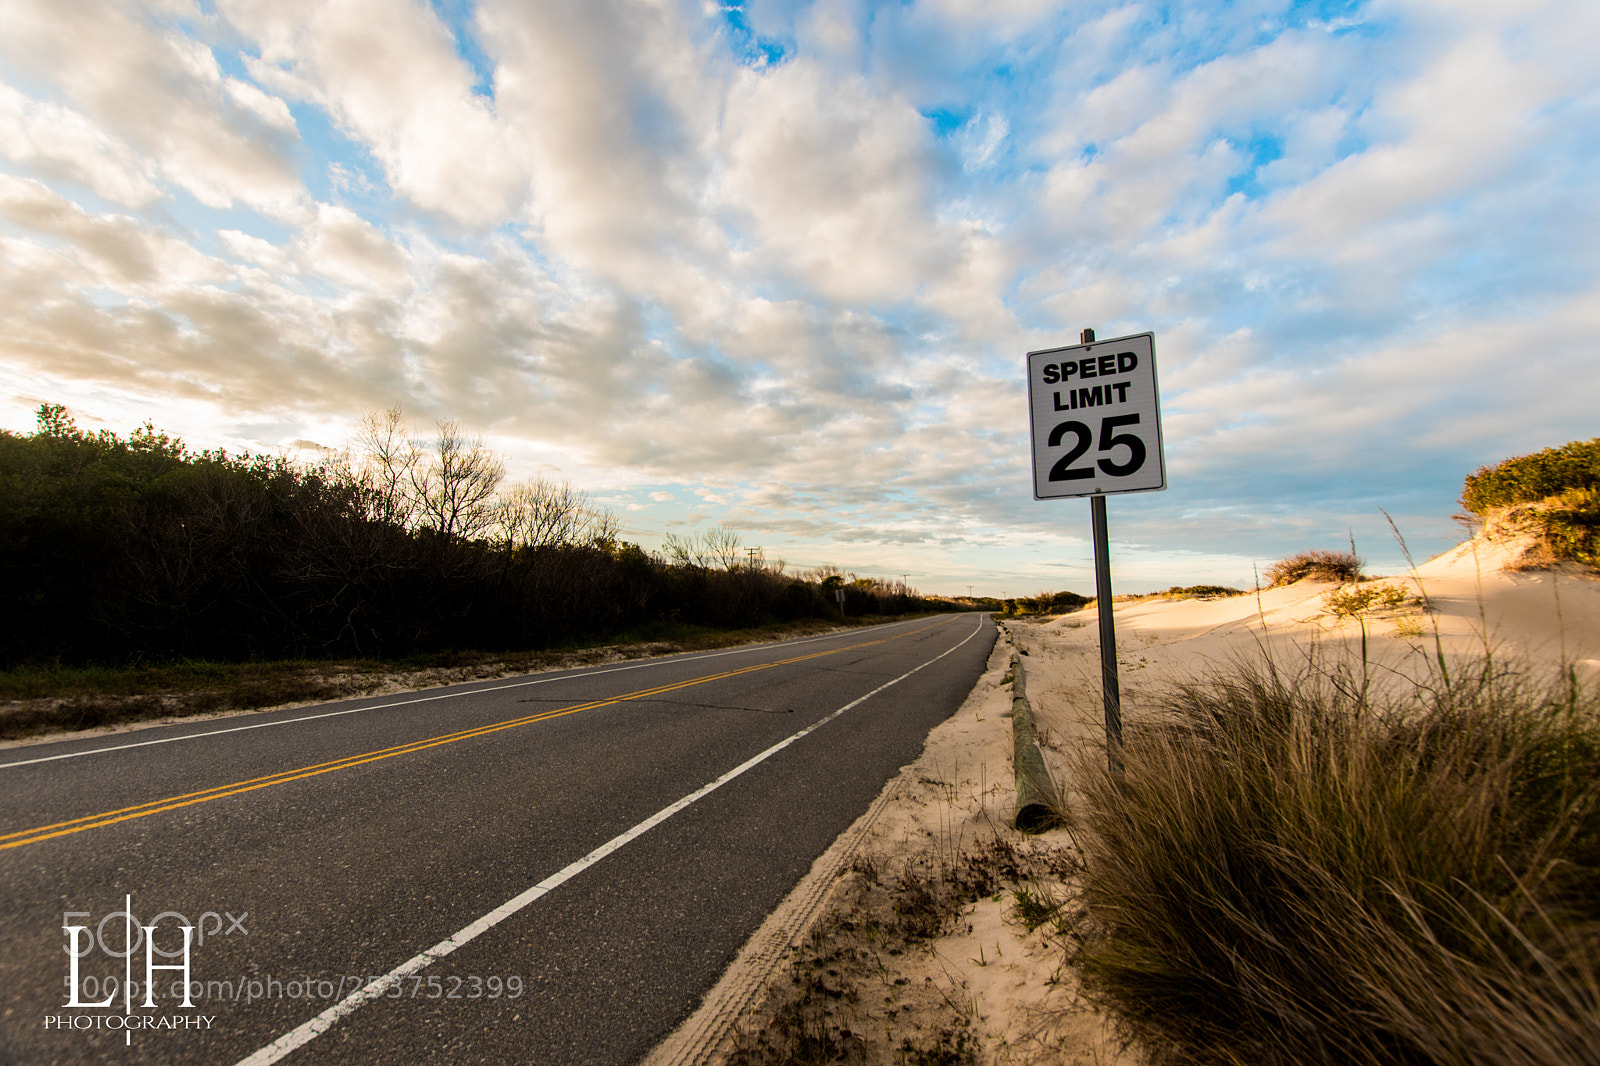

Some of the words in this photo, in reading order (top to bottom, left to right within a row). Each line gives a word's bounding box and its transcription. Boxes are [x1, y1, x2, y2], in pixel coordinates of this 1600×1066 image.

[1043, 351, 1138, 384] SPEED
[1053, 381, 1131, 411] LIMIT
[1048, 413, 1146, 482] 25
